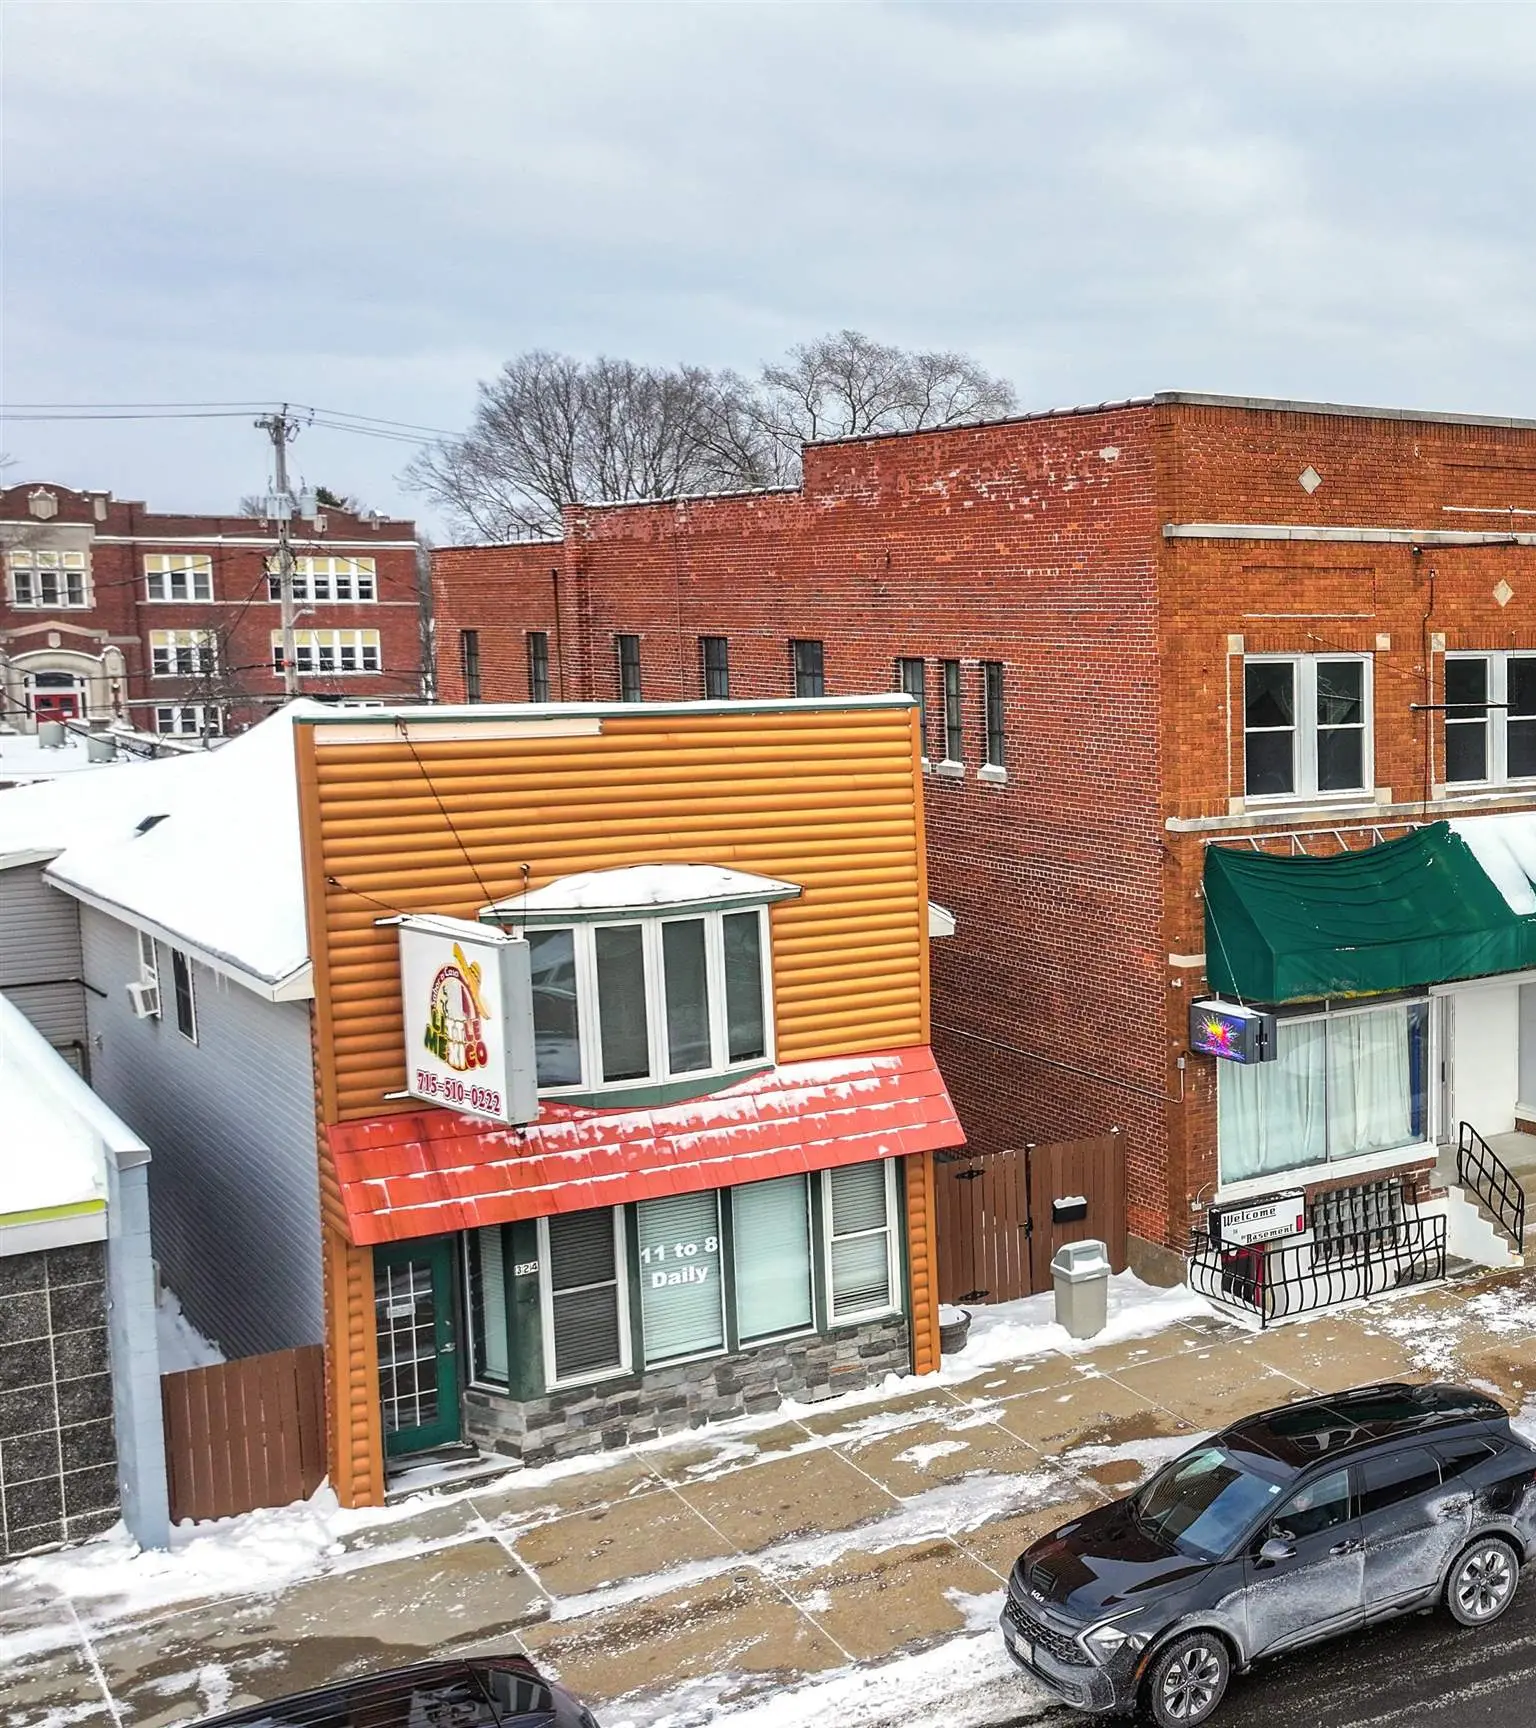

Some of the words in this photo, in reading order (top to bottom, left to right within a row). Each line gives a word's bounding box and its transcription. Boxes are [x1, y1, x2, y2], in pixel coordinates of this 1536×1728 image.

[424, 1023, 488, 1070] MEXICO
[417, 1070, 501, 1114] 715-510-0222
[1223, 1207, 1276, 1227] Welcome
[1246, 1224, 1293, 1243] Basement
[641, 1245, 665, 1263] 11
[674, 1242, 696, 1257] to
[704, 1236, 718, 1252] 8
[515, 1262, 538, 1275] 324
[652, 1265, 708, 1288] Daily
